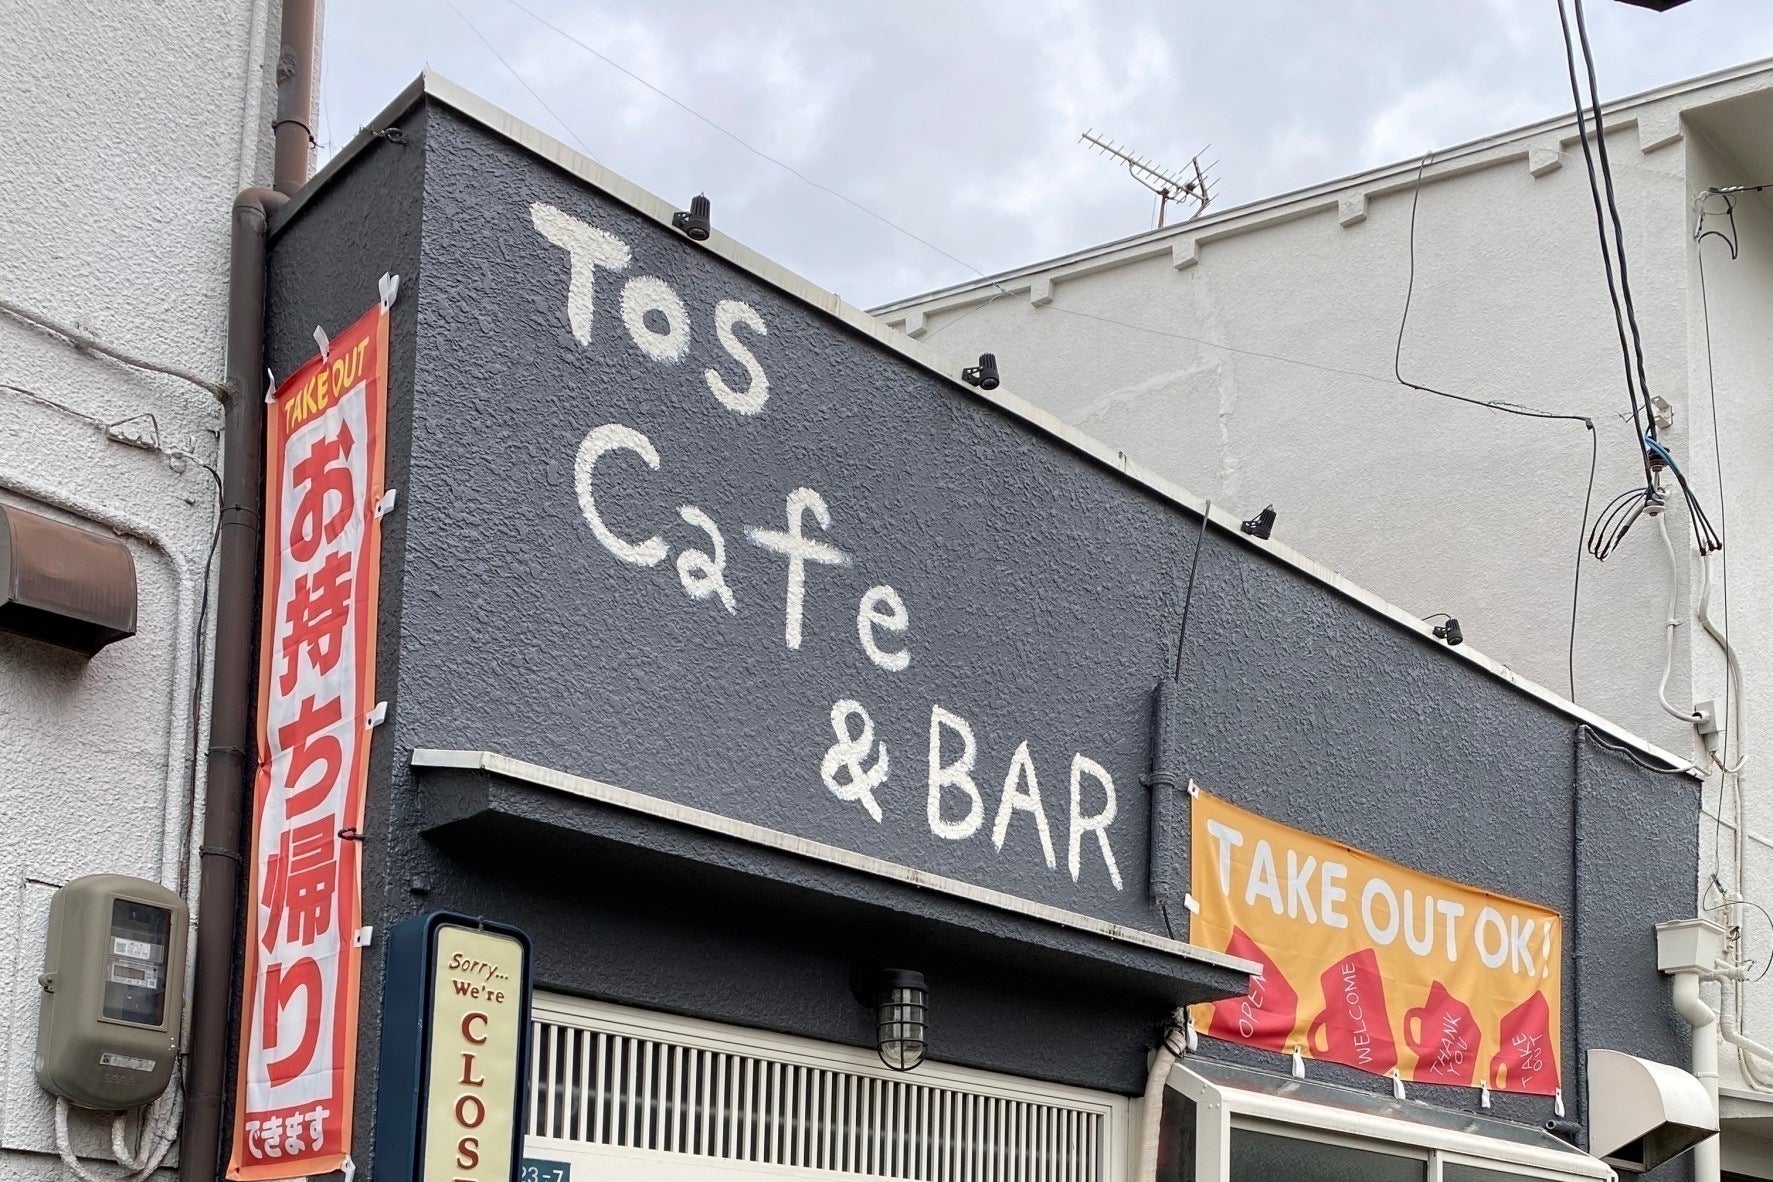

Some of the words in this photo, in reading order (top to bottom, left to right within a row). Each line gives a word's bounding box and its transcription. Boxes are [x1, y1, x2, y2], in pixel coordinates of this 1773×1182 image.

[285, 367, 329, 434] TAKE
[332, 336, 370, 398] OUT
[573, 422, 910, 671] Cafe
[261, 417, 355, 1089] お持ち帰り
[820, 698, 890, 824] &
[926, 703, 1124, 892] BAR
[1207, 818, 1349, 929] TAKE
[1361, 878, 1465, 962] OUT
[1474, 906, 1552, 979] OK!
[453, 979, 505, 1003] We're
[1346, 962, 1374, 1066] WELCOME
[1430, 1011, 1462, 1076] THANK
[1446, 1036, 1468, 1076] YOU
[1511, 1032, 1533, 1088] TAKE
[1529, 1034, 1543, 1072] OUT
[245, 1105, 330, 1160] できます
